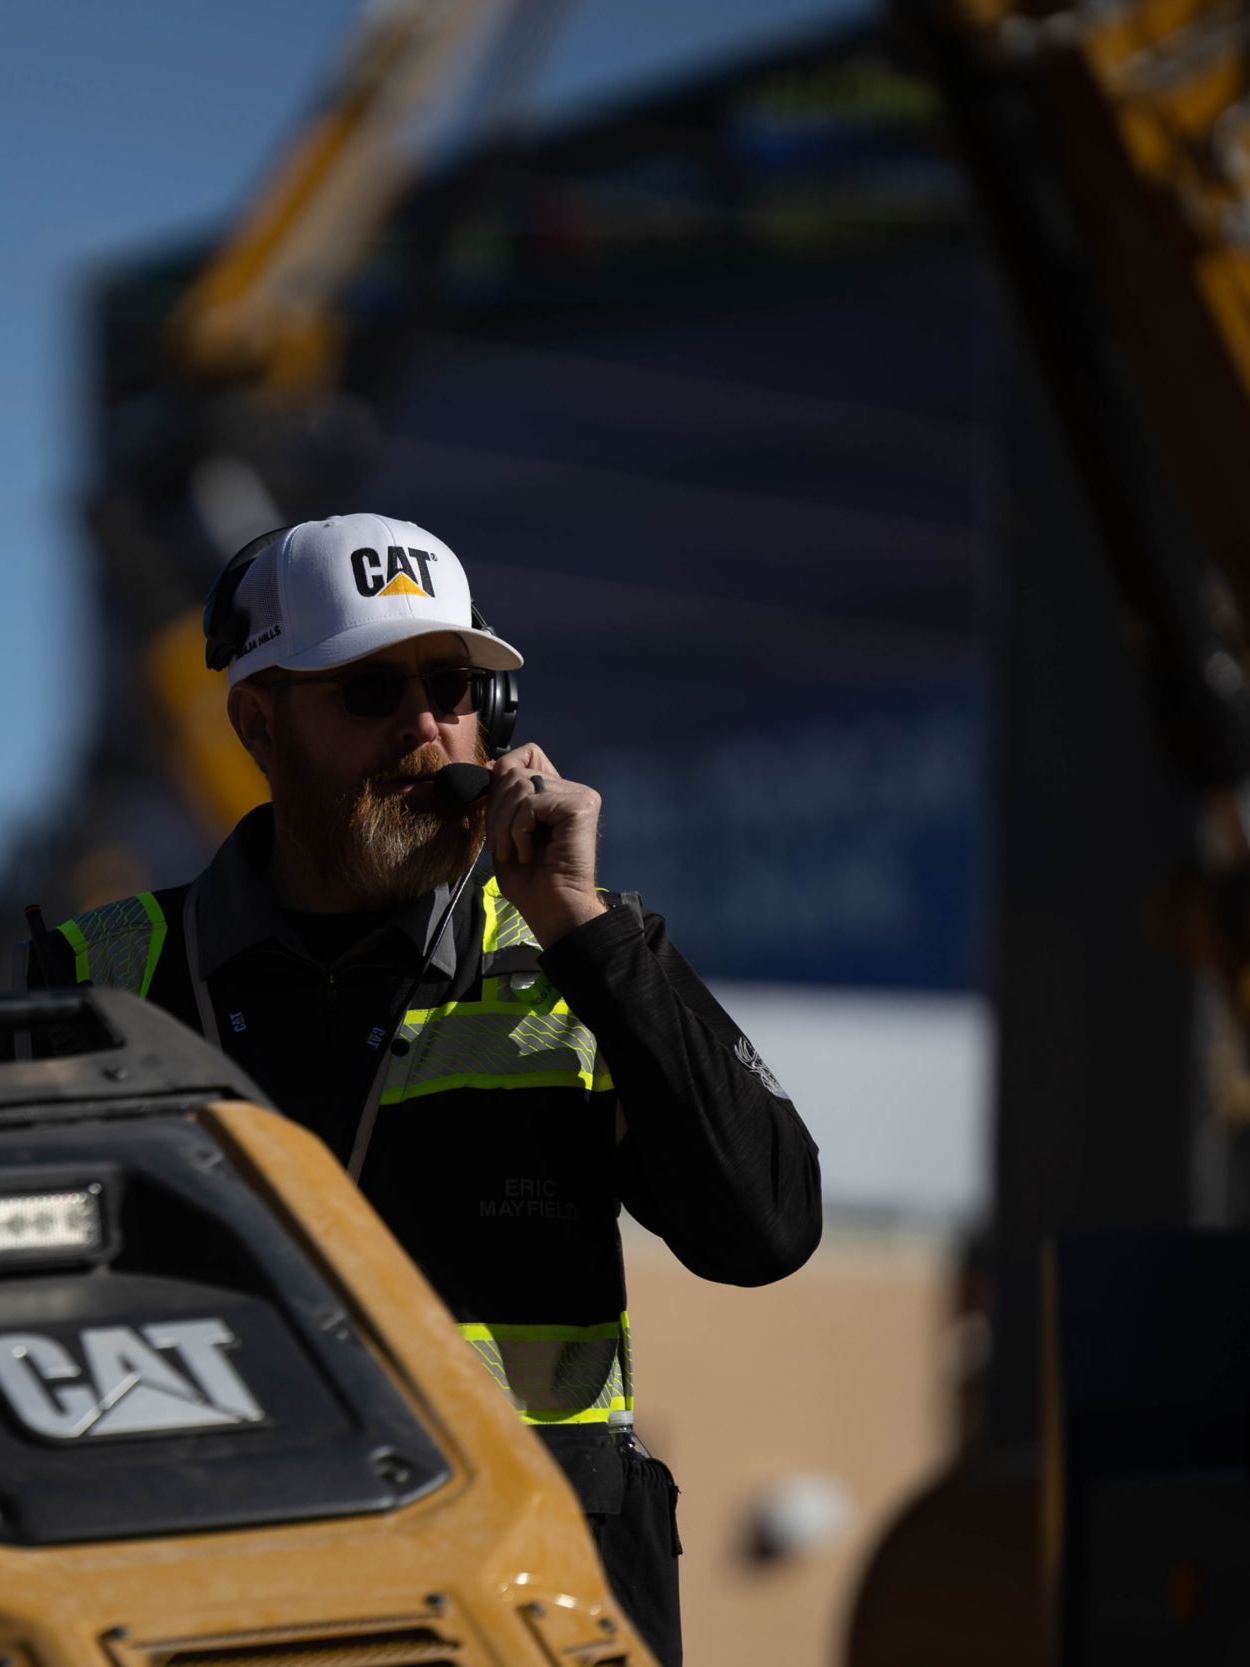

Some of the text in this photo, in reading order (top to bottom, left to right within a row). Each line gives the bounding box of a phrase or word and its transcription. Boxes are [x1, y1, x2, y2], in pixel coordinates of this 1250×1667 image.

[351, 546, 436, 598] CAT
[258, 624, 281, 646] HILLS
[504, 1178, 556, 1198] ERIC
[478, 1199, 578, 1220] MAYFIELD
